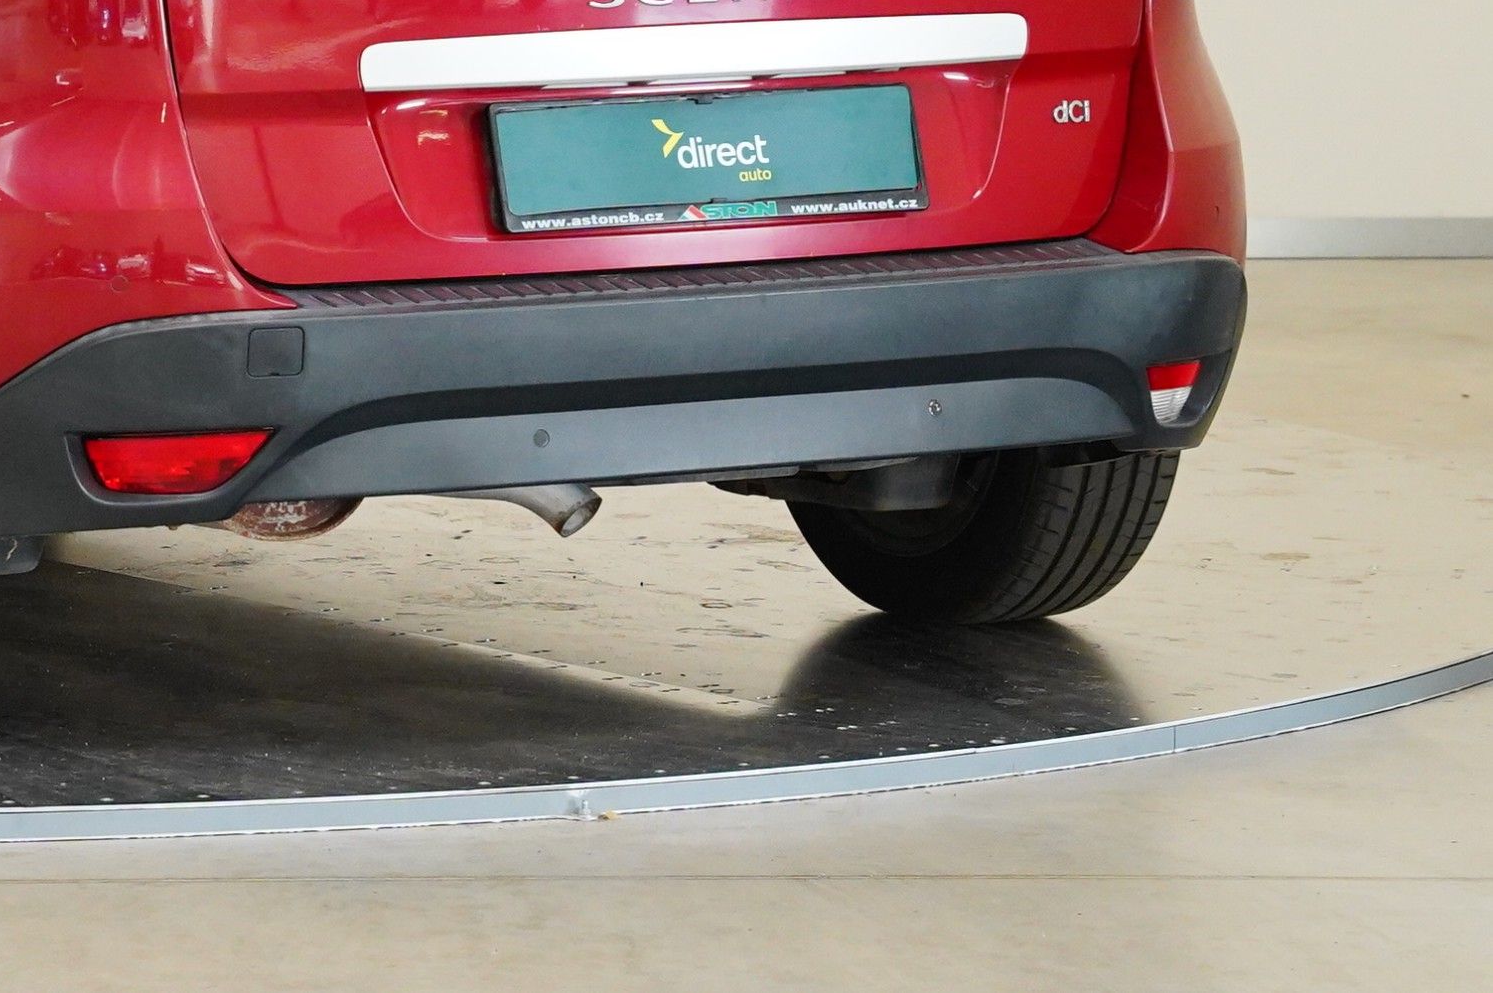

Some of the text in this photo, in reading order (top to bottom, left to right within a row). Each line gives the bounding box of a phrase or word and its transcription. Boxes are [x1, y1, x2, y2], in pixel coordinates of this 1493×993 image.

[1053, 99, 1091, 124] dCi
[677, 134, 770, 169] direct
[738, 167, 773, 182] auto
[521, 211, 664, 230] www.astoncb.cz
[790, 197, 919, 215] www.auknet.cz
